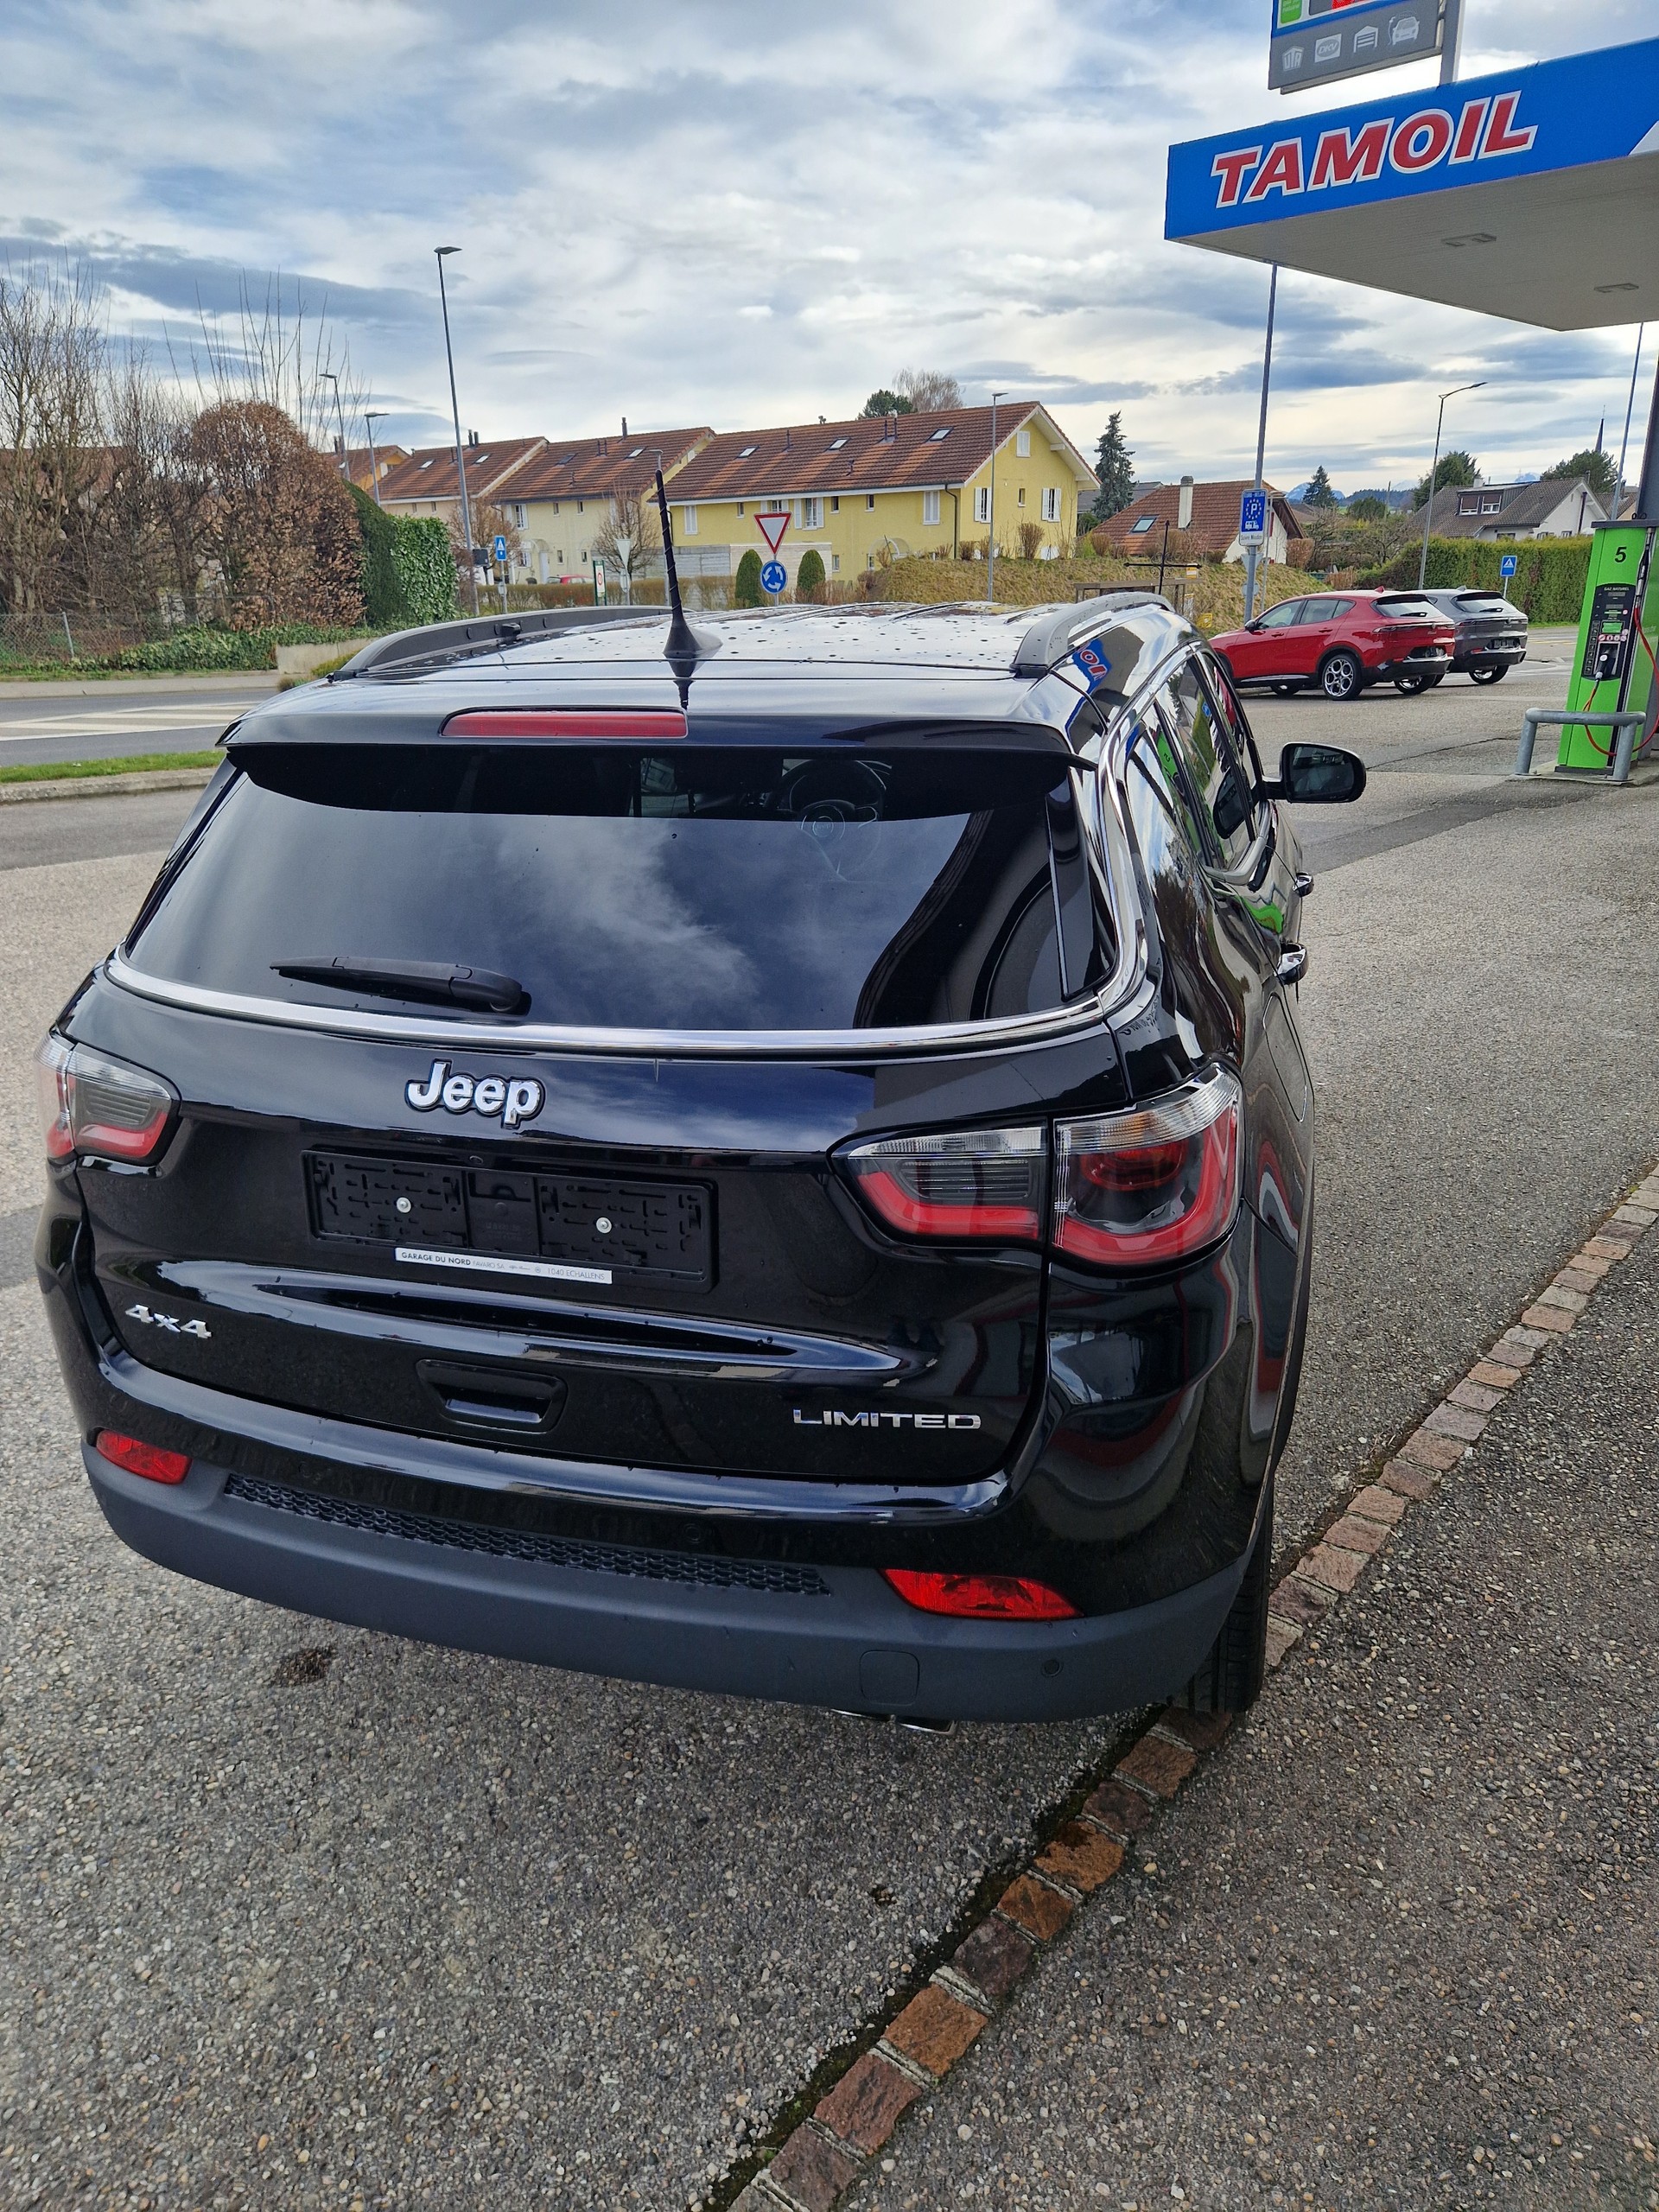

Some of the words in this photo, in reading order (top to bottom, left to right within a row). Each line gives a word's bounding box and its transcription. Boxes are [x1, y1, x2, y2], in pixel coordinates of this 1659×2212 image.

[1319, 41, 1338, 54] DKV
[1211, 90, 1538, 209] TAMOIL
[1250, 503, 1258, 515] P
[1614, 546, 1627, 563] 5
[405, 1060, 544, 1128] Jeep
[401, 1251, 433, 1262] GARAGE
[448, 1257, 471, 1266] NORD
[547, 1268, 564, 1276] 1040
[566, 1269, 605, 1281] ECHALLENS
[792, 1408, 982, 1429] LIMITED
